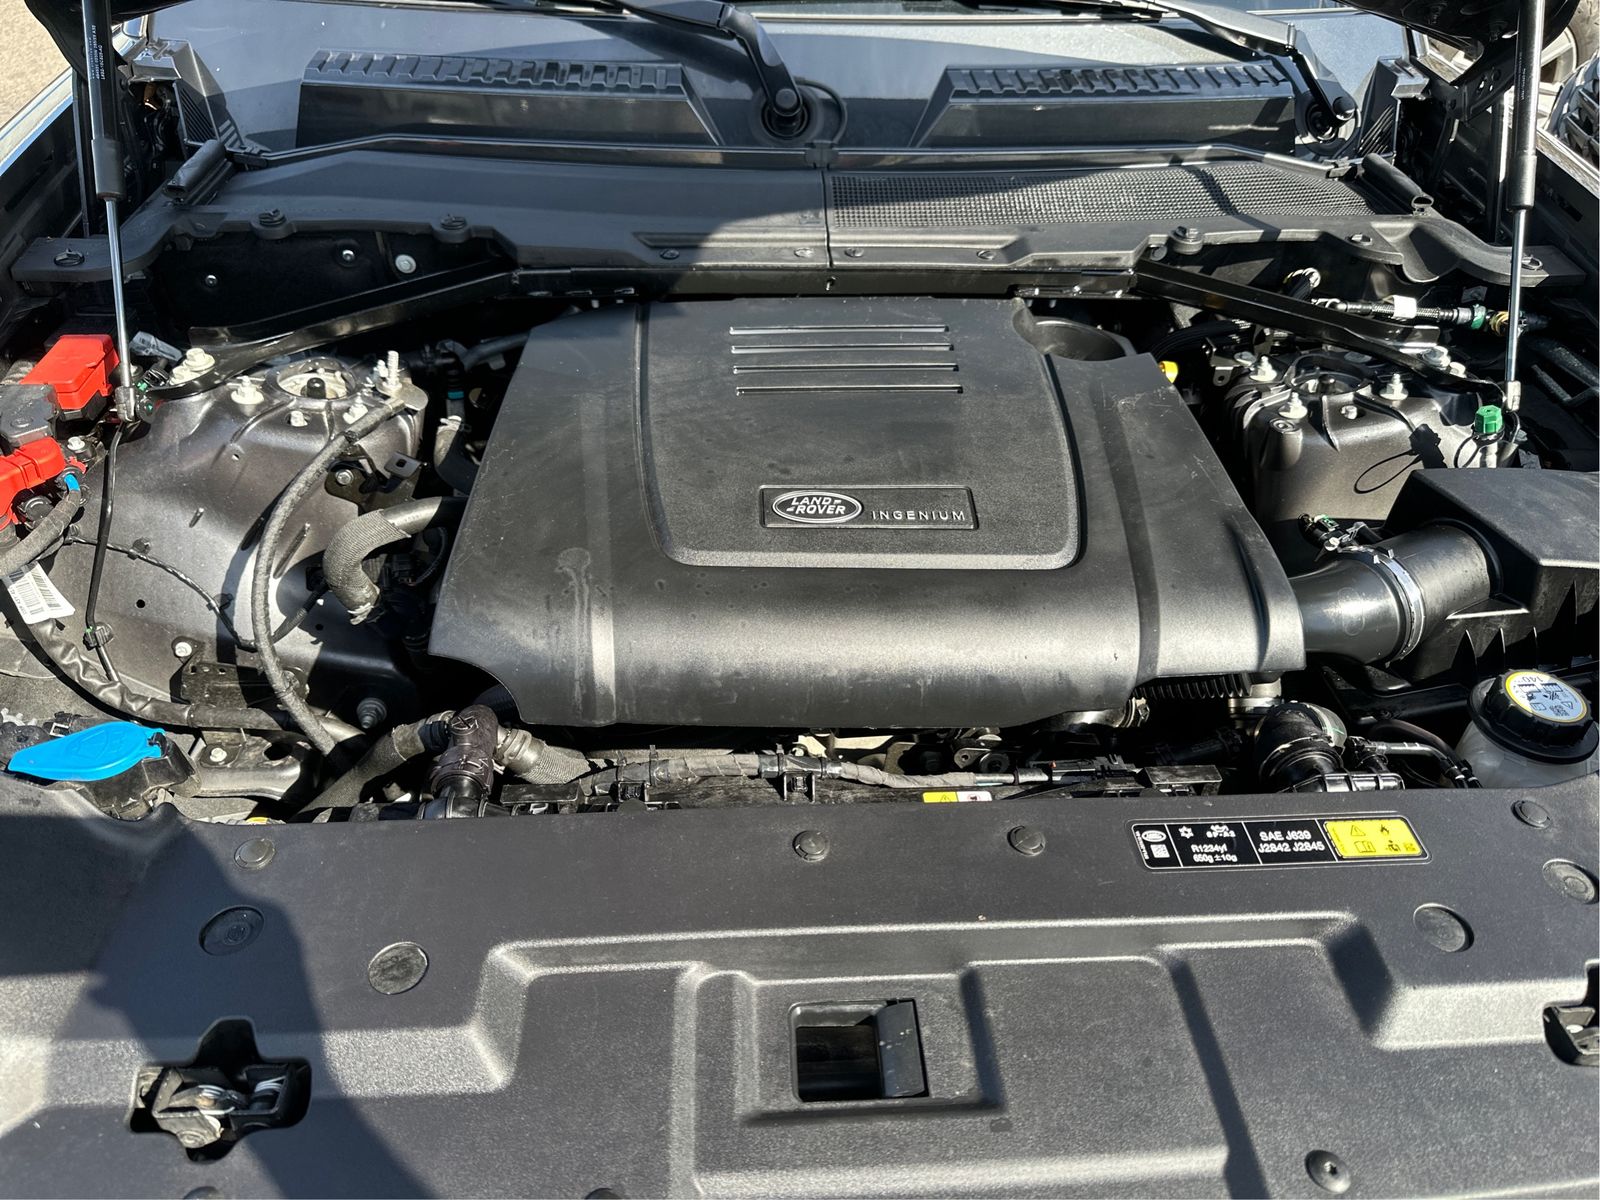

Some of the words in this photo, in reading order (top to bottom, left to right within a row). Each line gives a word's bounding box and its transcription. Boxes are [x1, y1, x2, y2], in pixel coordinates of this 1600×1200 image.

[791, 497, 833, 506] LAND
[795, 505, 846, 515] ROVER
[872, 510, 966, 520] INGENIUM
[1259, 831, 1285, 841] SAE
[1285, 830, 1312, 840] J639
[1190, 843, 1228, 854] R1234yf
[1258, 842, 1291, 853] J2842
[1292, 841, 1326, 852] J2845
